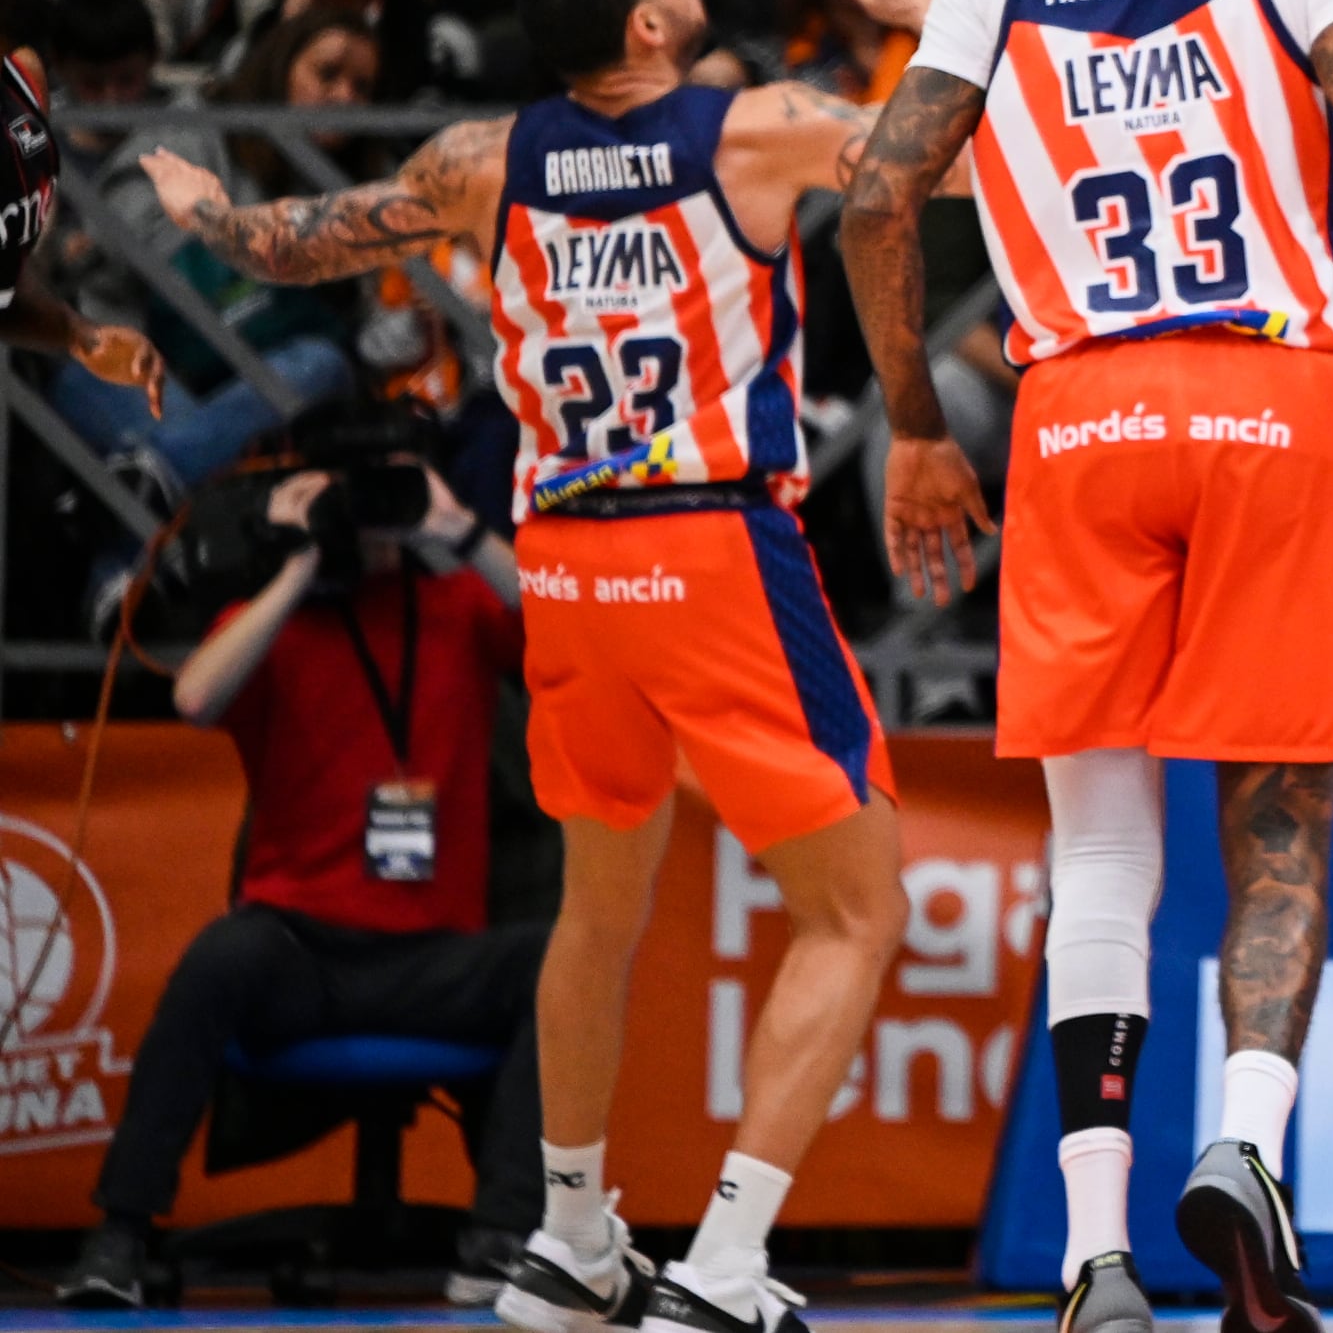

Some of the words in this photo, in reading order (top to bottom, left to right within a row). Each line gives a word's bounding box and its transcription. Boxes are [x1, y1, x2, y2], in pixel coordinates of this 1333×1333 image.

[1065, 38, 1223, 119] LEYMA
[1124, 111, 1181, 131] NATURA
[545, 141, 673, 197] BARRUETA
[545, 230, 682, 291] LEYMA
[1071, 153, 1250, 314] 33
[542, 336, 682, 458] 23
[1037, 402, 1167, 459] Nordés
[1188, 408, 1291, 449] ancín
[594, 564, 686, 603] ancín
[1108, 1014, 1132, 1067] COMP
